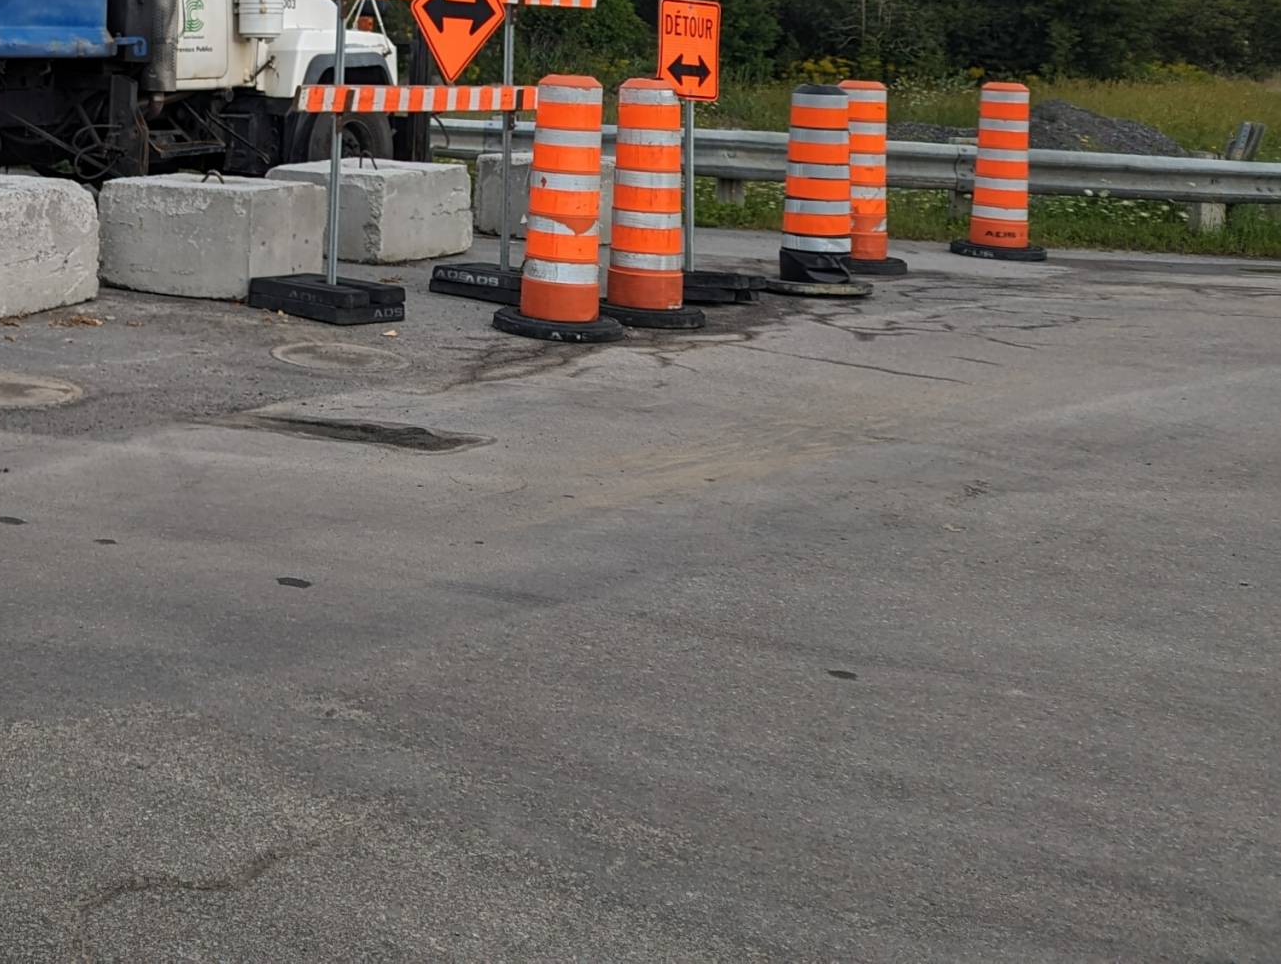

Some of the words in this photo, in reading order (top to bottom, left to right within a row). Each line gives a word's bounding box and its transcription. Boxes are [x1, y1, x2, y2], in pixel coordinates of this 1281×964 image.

[665, 10, 713, 39] DÉTOUR
[466, 275, 499, 287] ADS
[374, 307, 403, 318] ADS
